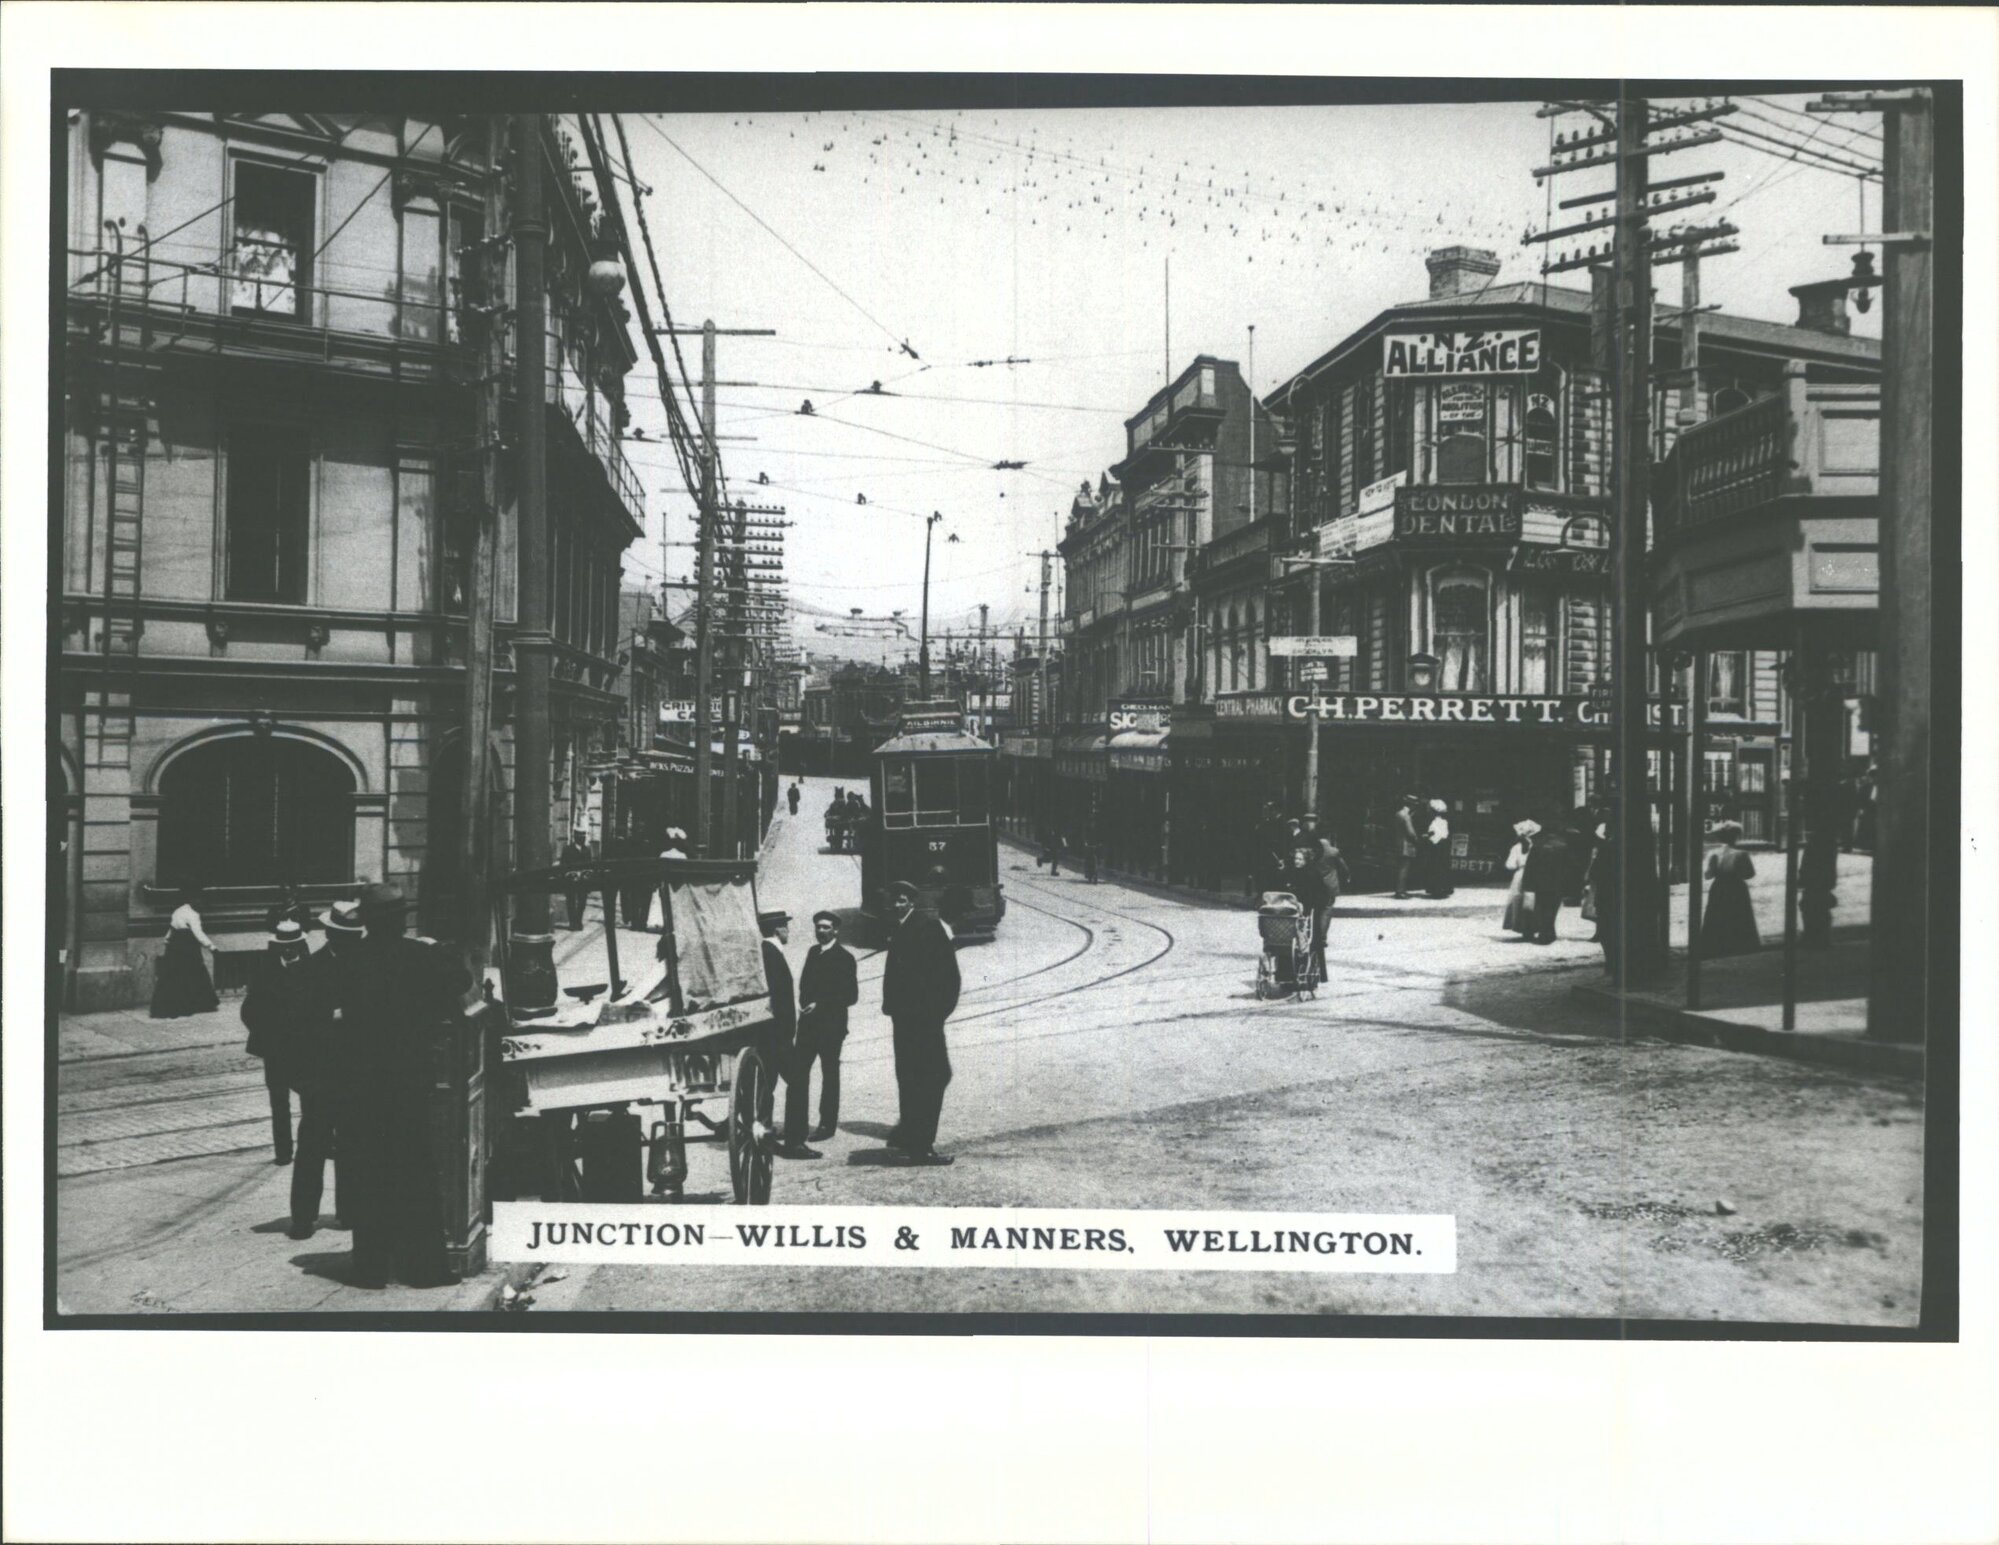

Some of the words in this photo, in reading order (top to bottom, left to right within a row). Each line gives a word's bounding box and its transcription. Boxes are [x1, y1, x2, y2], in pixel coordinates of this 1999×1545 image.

[1386, 332, 1539, 374] ALLIANCE
[1410, 492, 1508, 511] LONDON
[1400, 513, 1517, 535] DENTAL
[1216, 698, 1244, 716] CENTRAL
[1246, 696, 1284, 716] PHARMACY
